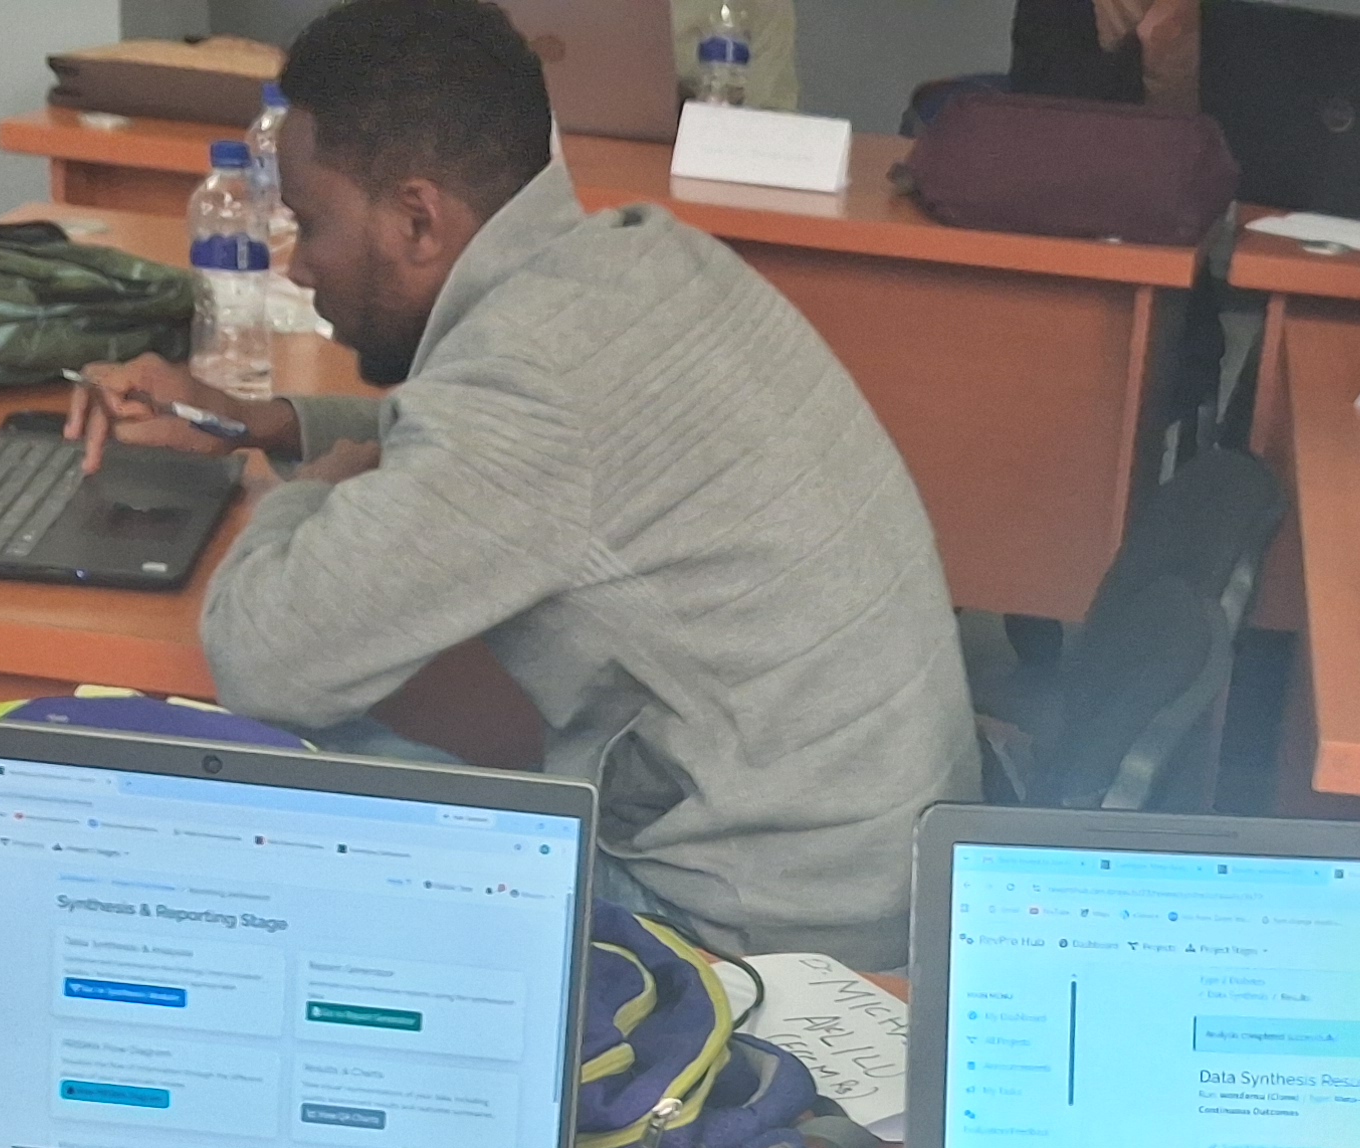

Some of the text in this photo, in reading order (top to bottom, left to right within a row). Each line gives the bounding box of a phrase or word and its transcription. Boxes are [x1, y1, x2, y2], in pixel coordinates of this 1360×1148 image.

[56, 893, 289, 934] Synthesis & Reporting Stage
[1020, 937, 1046, 948] Hub
[808, 979, 908, 1046] MICH
[1199, 1068, 1236, 1085] Data
[1240, 1070, 1317, 1090] Synthesis
[1252, 1106, 1300, 1118] Outcomes
